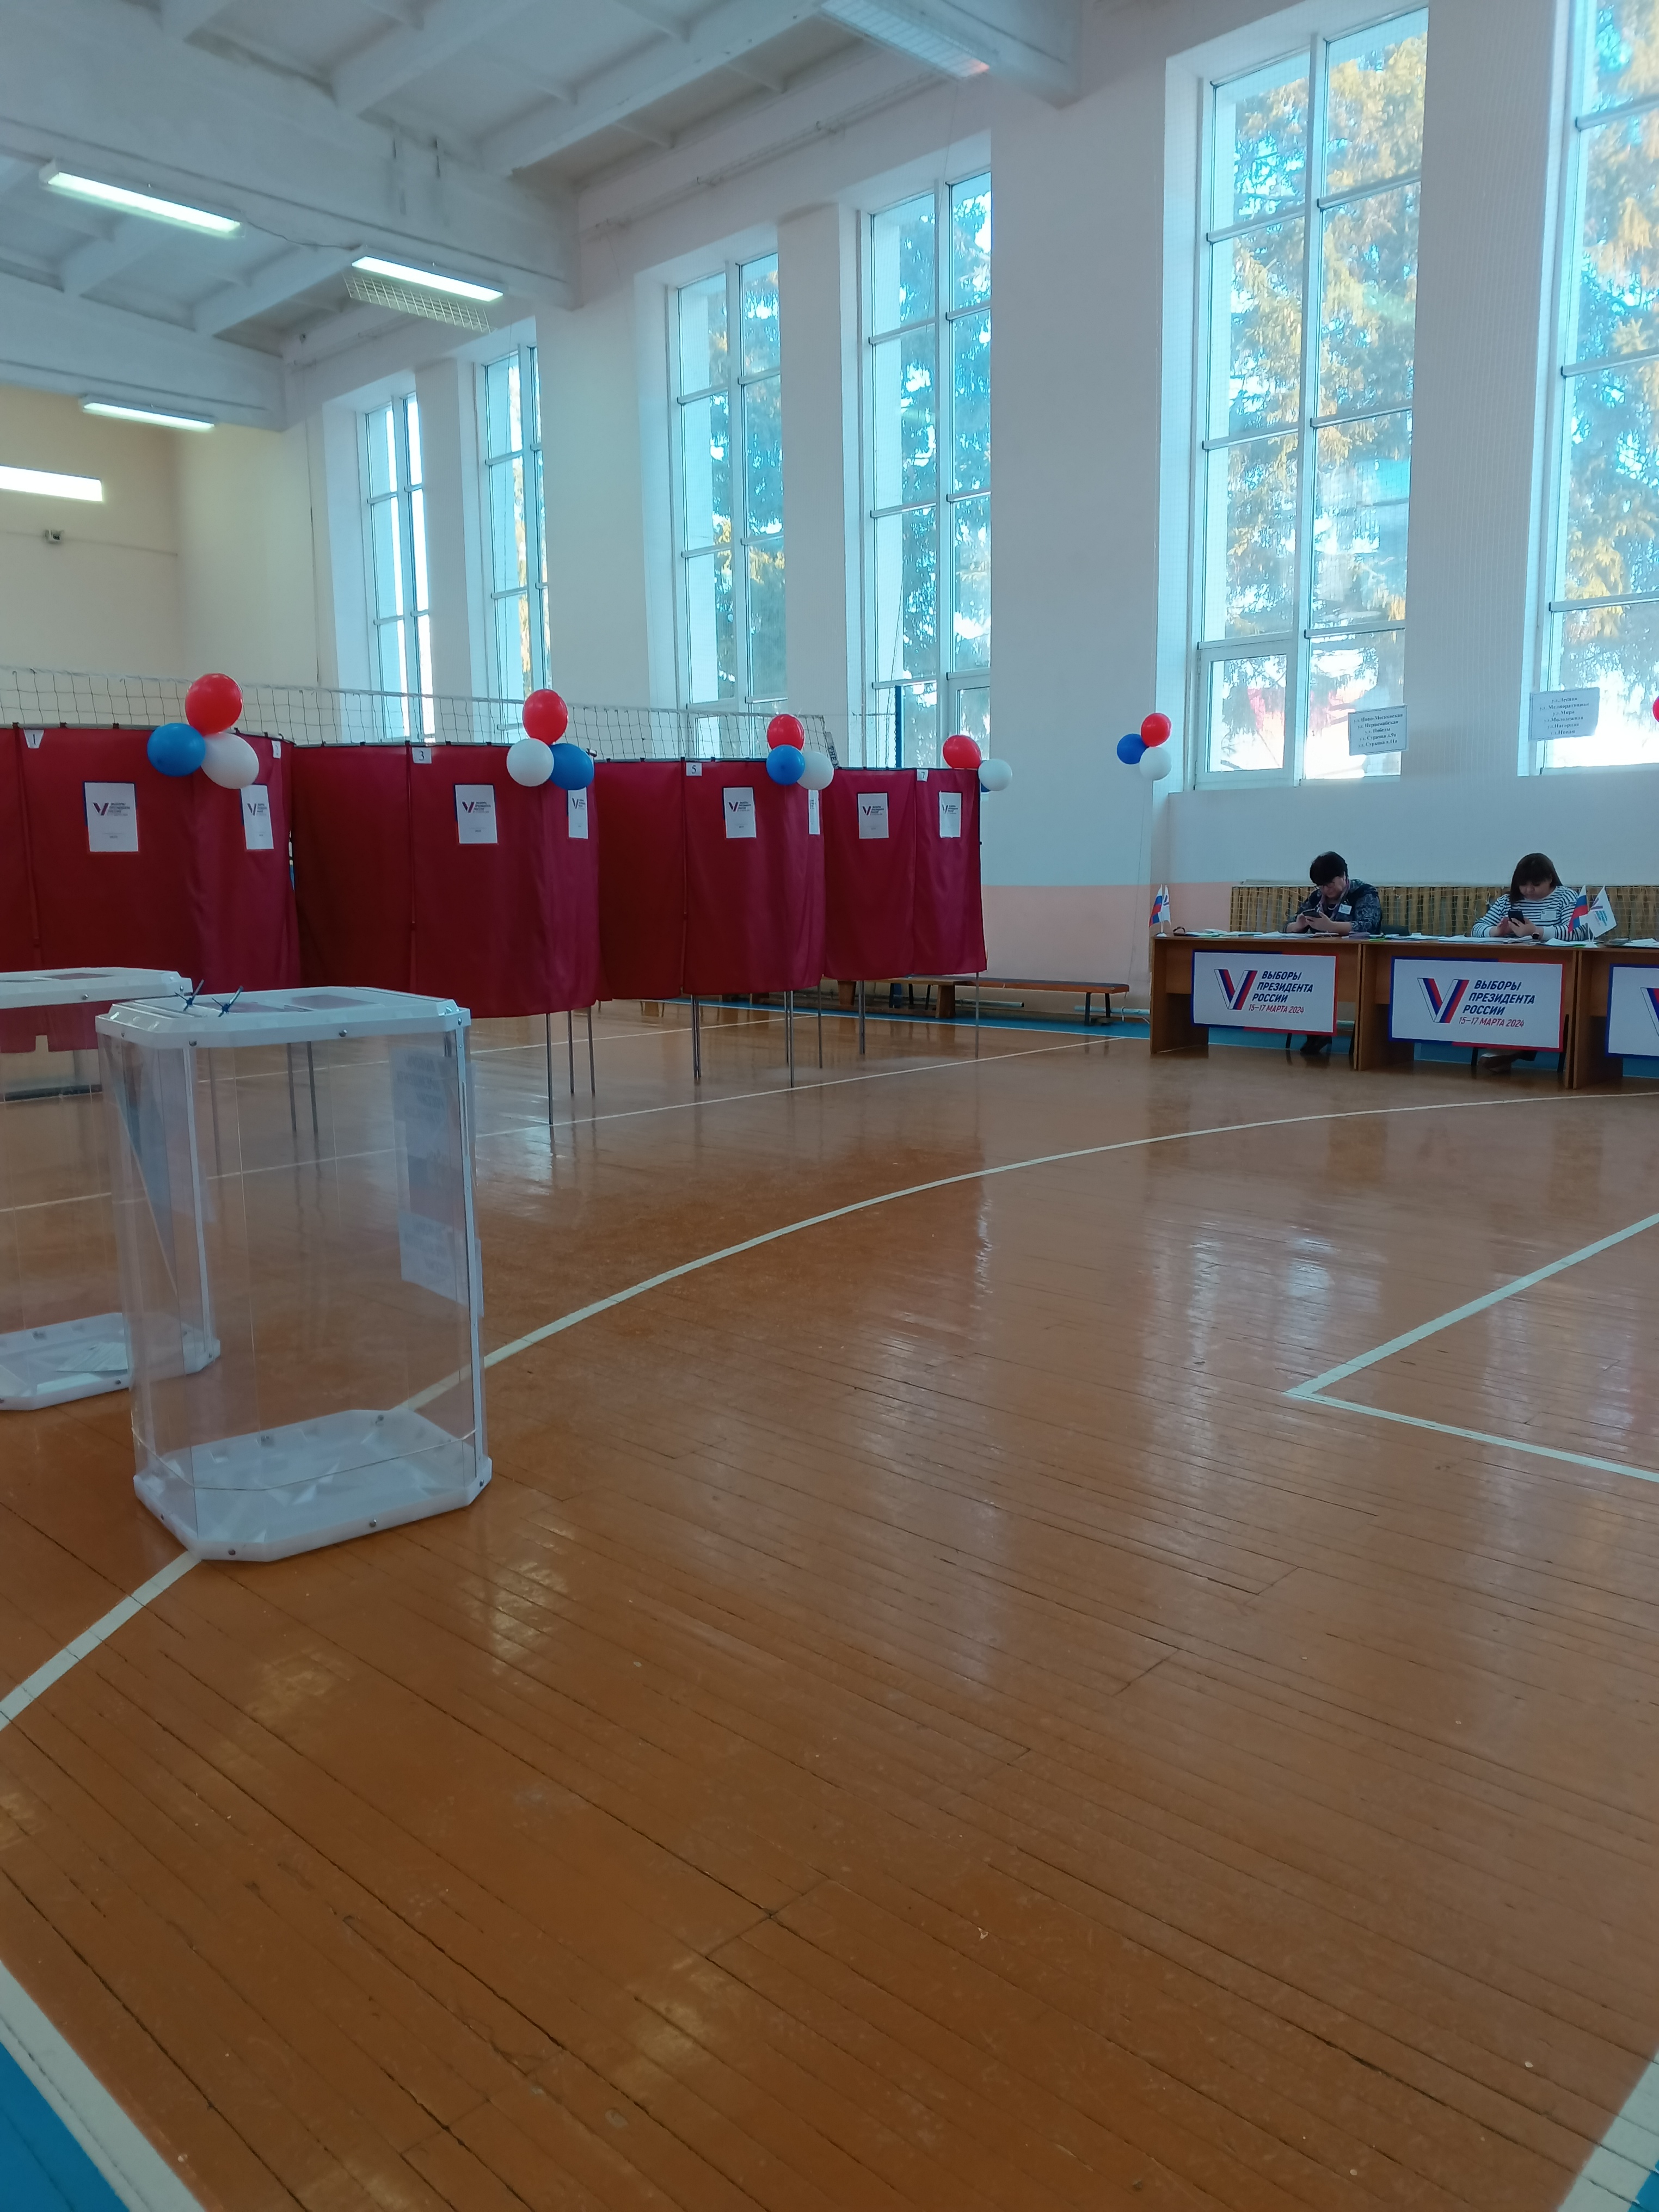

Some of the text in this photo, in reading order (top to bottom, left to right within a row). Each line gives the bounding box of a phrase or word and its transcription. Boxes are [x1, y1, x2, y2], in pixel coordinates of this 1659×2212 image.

[33, 734, 36, 746] 1
[419, 750, 425, 761] 3
[691, 765, 697, 775] 5
[1262, 970, 1302, 981] ВЫБОРЫ
[1257, 982, 1313, 993] ПРЕЗИДЕНТА
[1474, 980, 1522, 991] ВЫБОРЫ
[1252, 993, 1289, 1003] РОССИИ
[1468, 992, 1535, 1005] ПРЕЗИДЕНТА
[1265, 1005, 1288, 1013] МАРТА
[1463, 1005, 1506, 1016] РОССИИ
[1479, 1017, 1505, 1027] МАРТА
[1506, 1019, 1525, 1028] 2024
